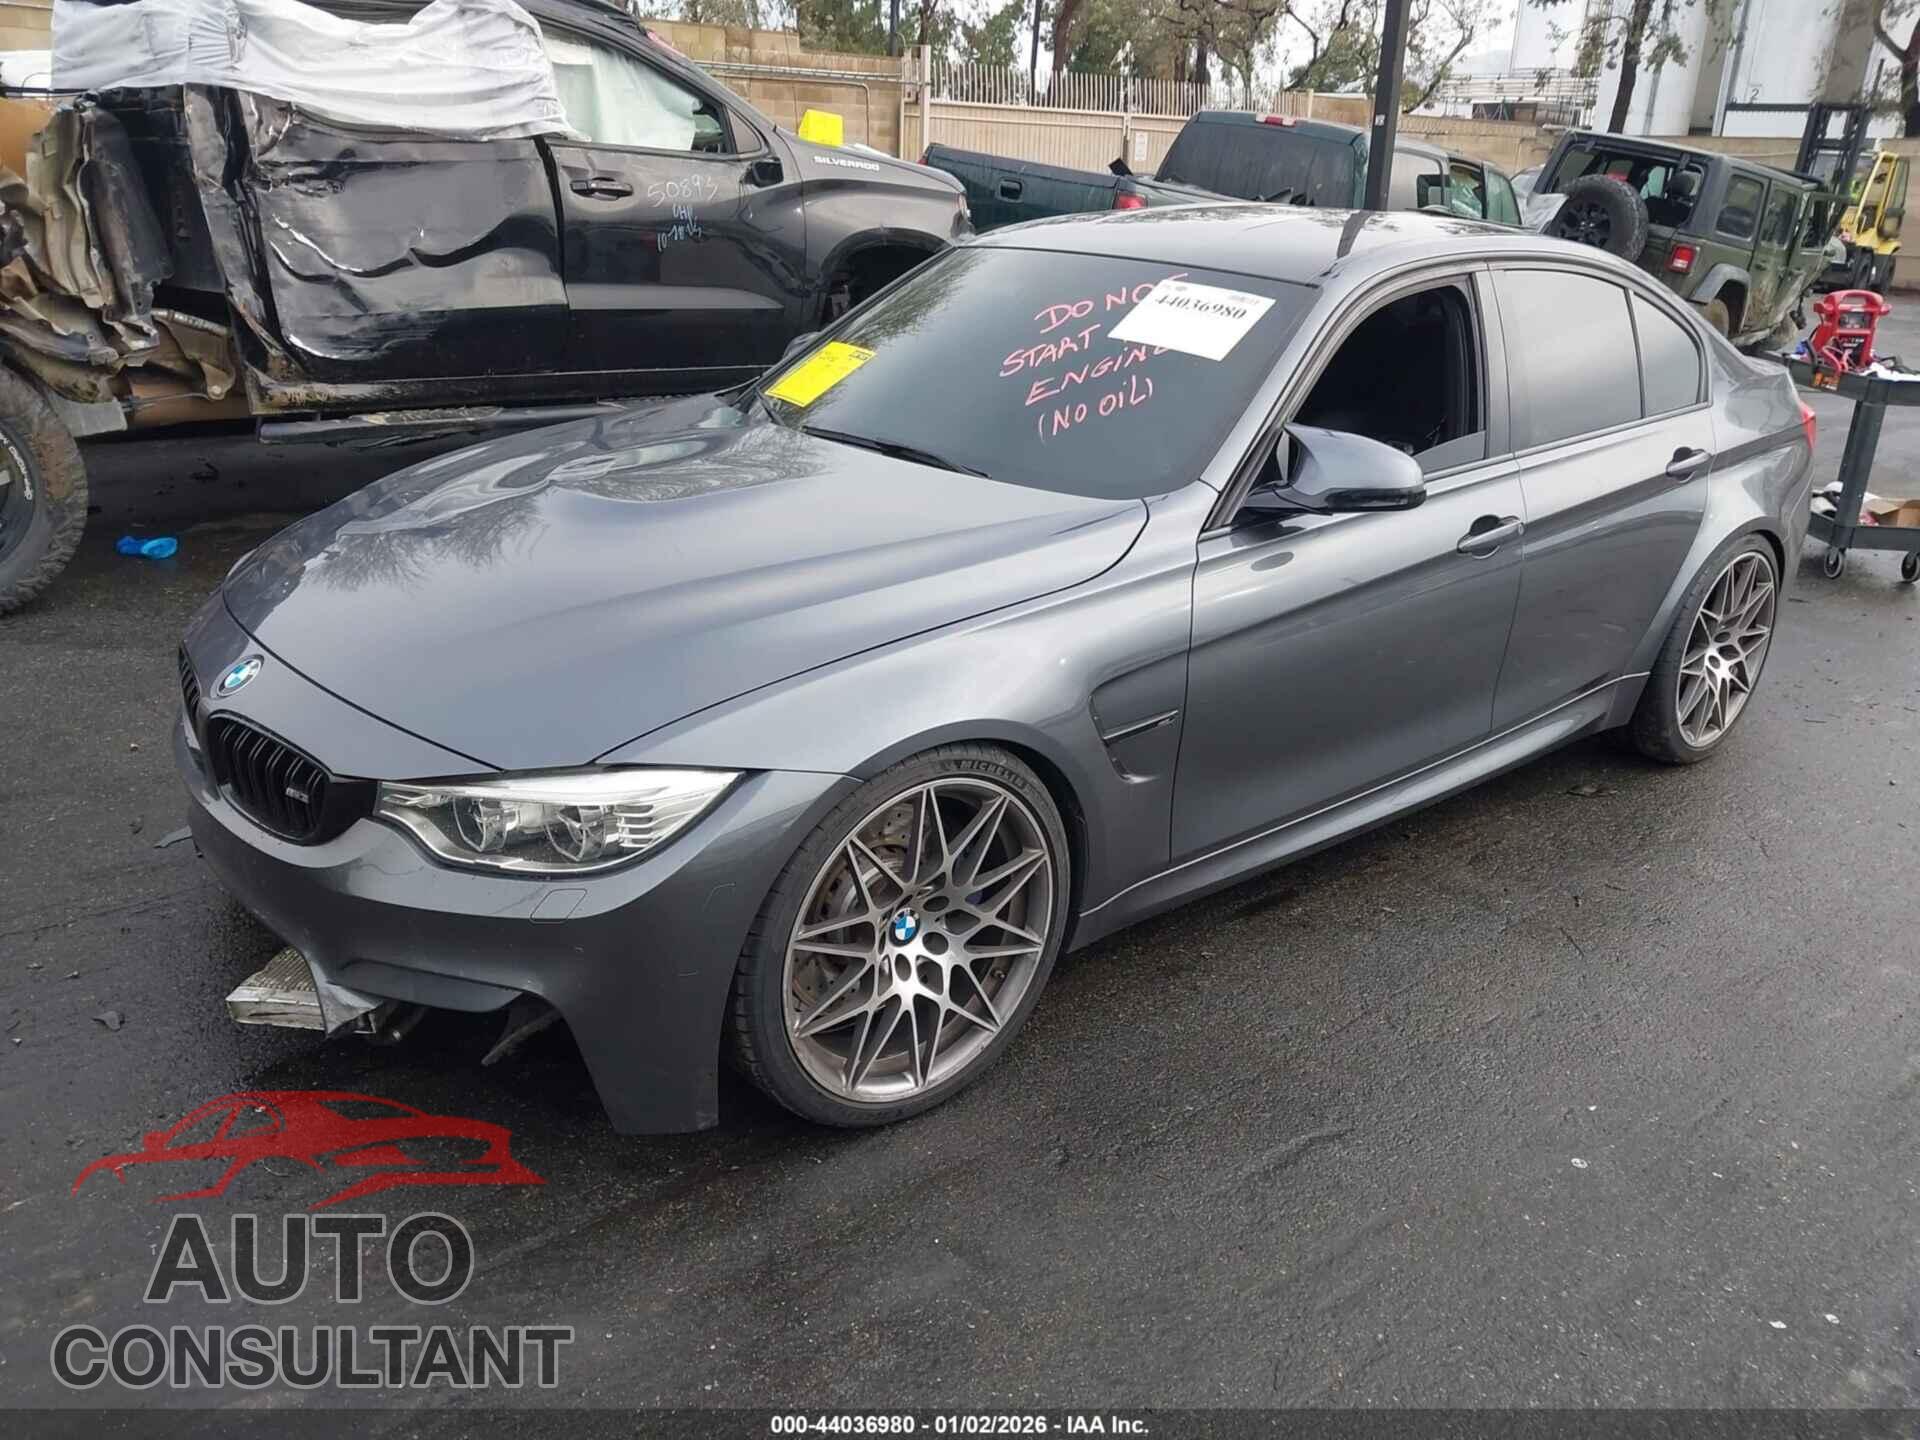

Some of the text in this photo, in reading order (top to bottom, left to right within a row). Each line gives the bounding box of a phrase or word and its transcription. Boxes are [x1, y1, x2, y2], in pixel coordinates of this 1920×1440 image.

[814, 155, 880, 171] SILVERADO
[1034, 299, 1094, 334] DO
[1155, 294, 1248, 319] 44036980
[999, 323, 1102, 378] START
[1038, 403, 1088, 444] (NO
